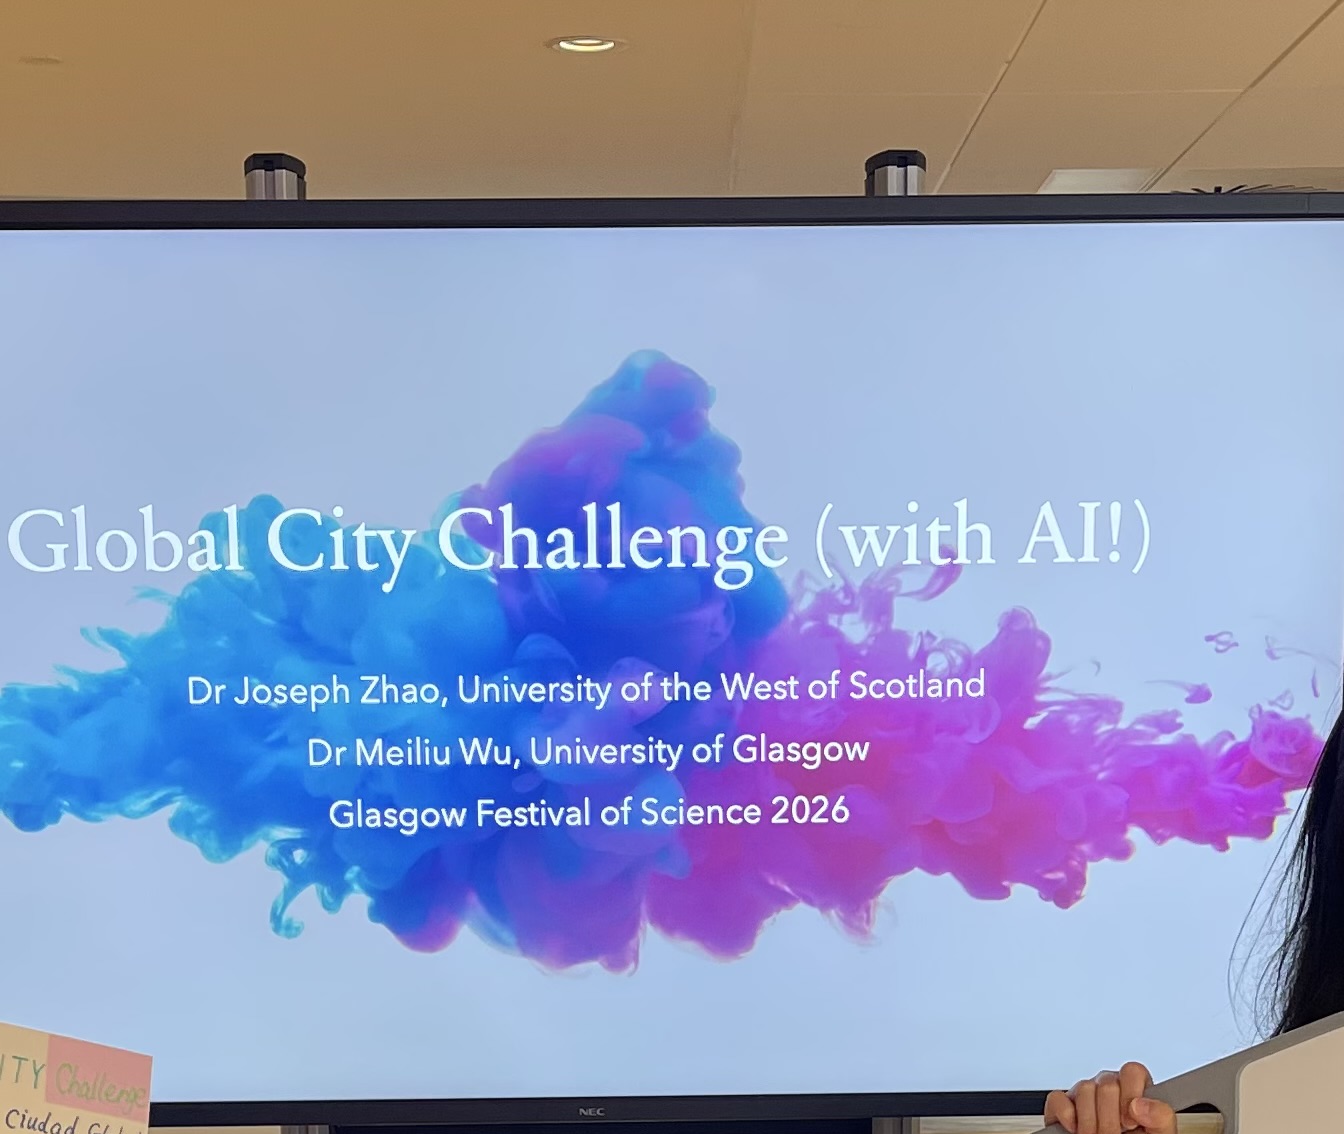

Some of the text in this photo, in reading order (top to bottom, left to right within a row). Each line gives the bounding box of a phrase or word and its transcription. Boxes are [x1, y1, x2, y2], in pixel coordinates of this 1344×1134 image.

[7, 498, 1151, 593] Global City Challenge (with AI!)
[188, 668, 987, 712] Dr Joseph Zhao, University of the West of Scotland
[308, 733, 871, 772] Dr Meiliu Wu, University of Glasgow
[329, 795, 852, 836] Glasgow Festival of Science 2026
[55, 1061, 148, 1114] Challenge
[578, 1107, 606, 1117] NEC
